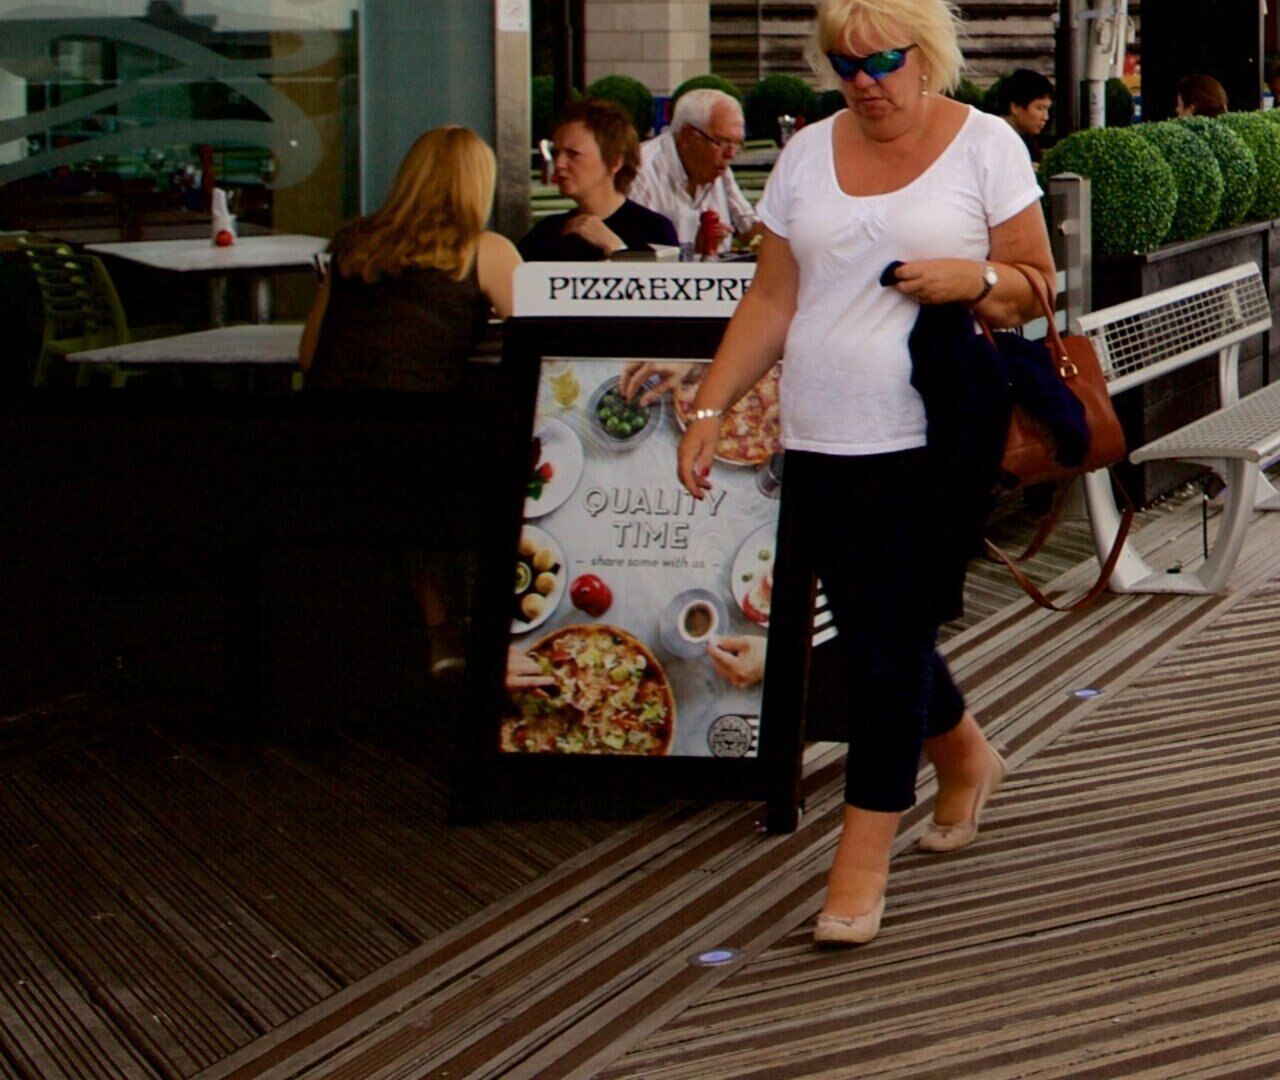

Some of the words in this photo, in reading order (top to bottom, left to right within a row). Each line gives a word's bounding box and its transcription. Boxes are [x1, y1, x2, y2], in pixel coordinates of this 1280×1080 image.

[547, 276, 753, 301] PIZZAEXPRE
[583, 487, 727, 518] QUALITY
[613, 521, 690, 550] TIME
[590, 554, 625, 568] share
[627, 558, 658, 568] some
[662, 557, 688, 569] with
